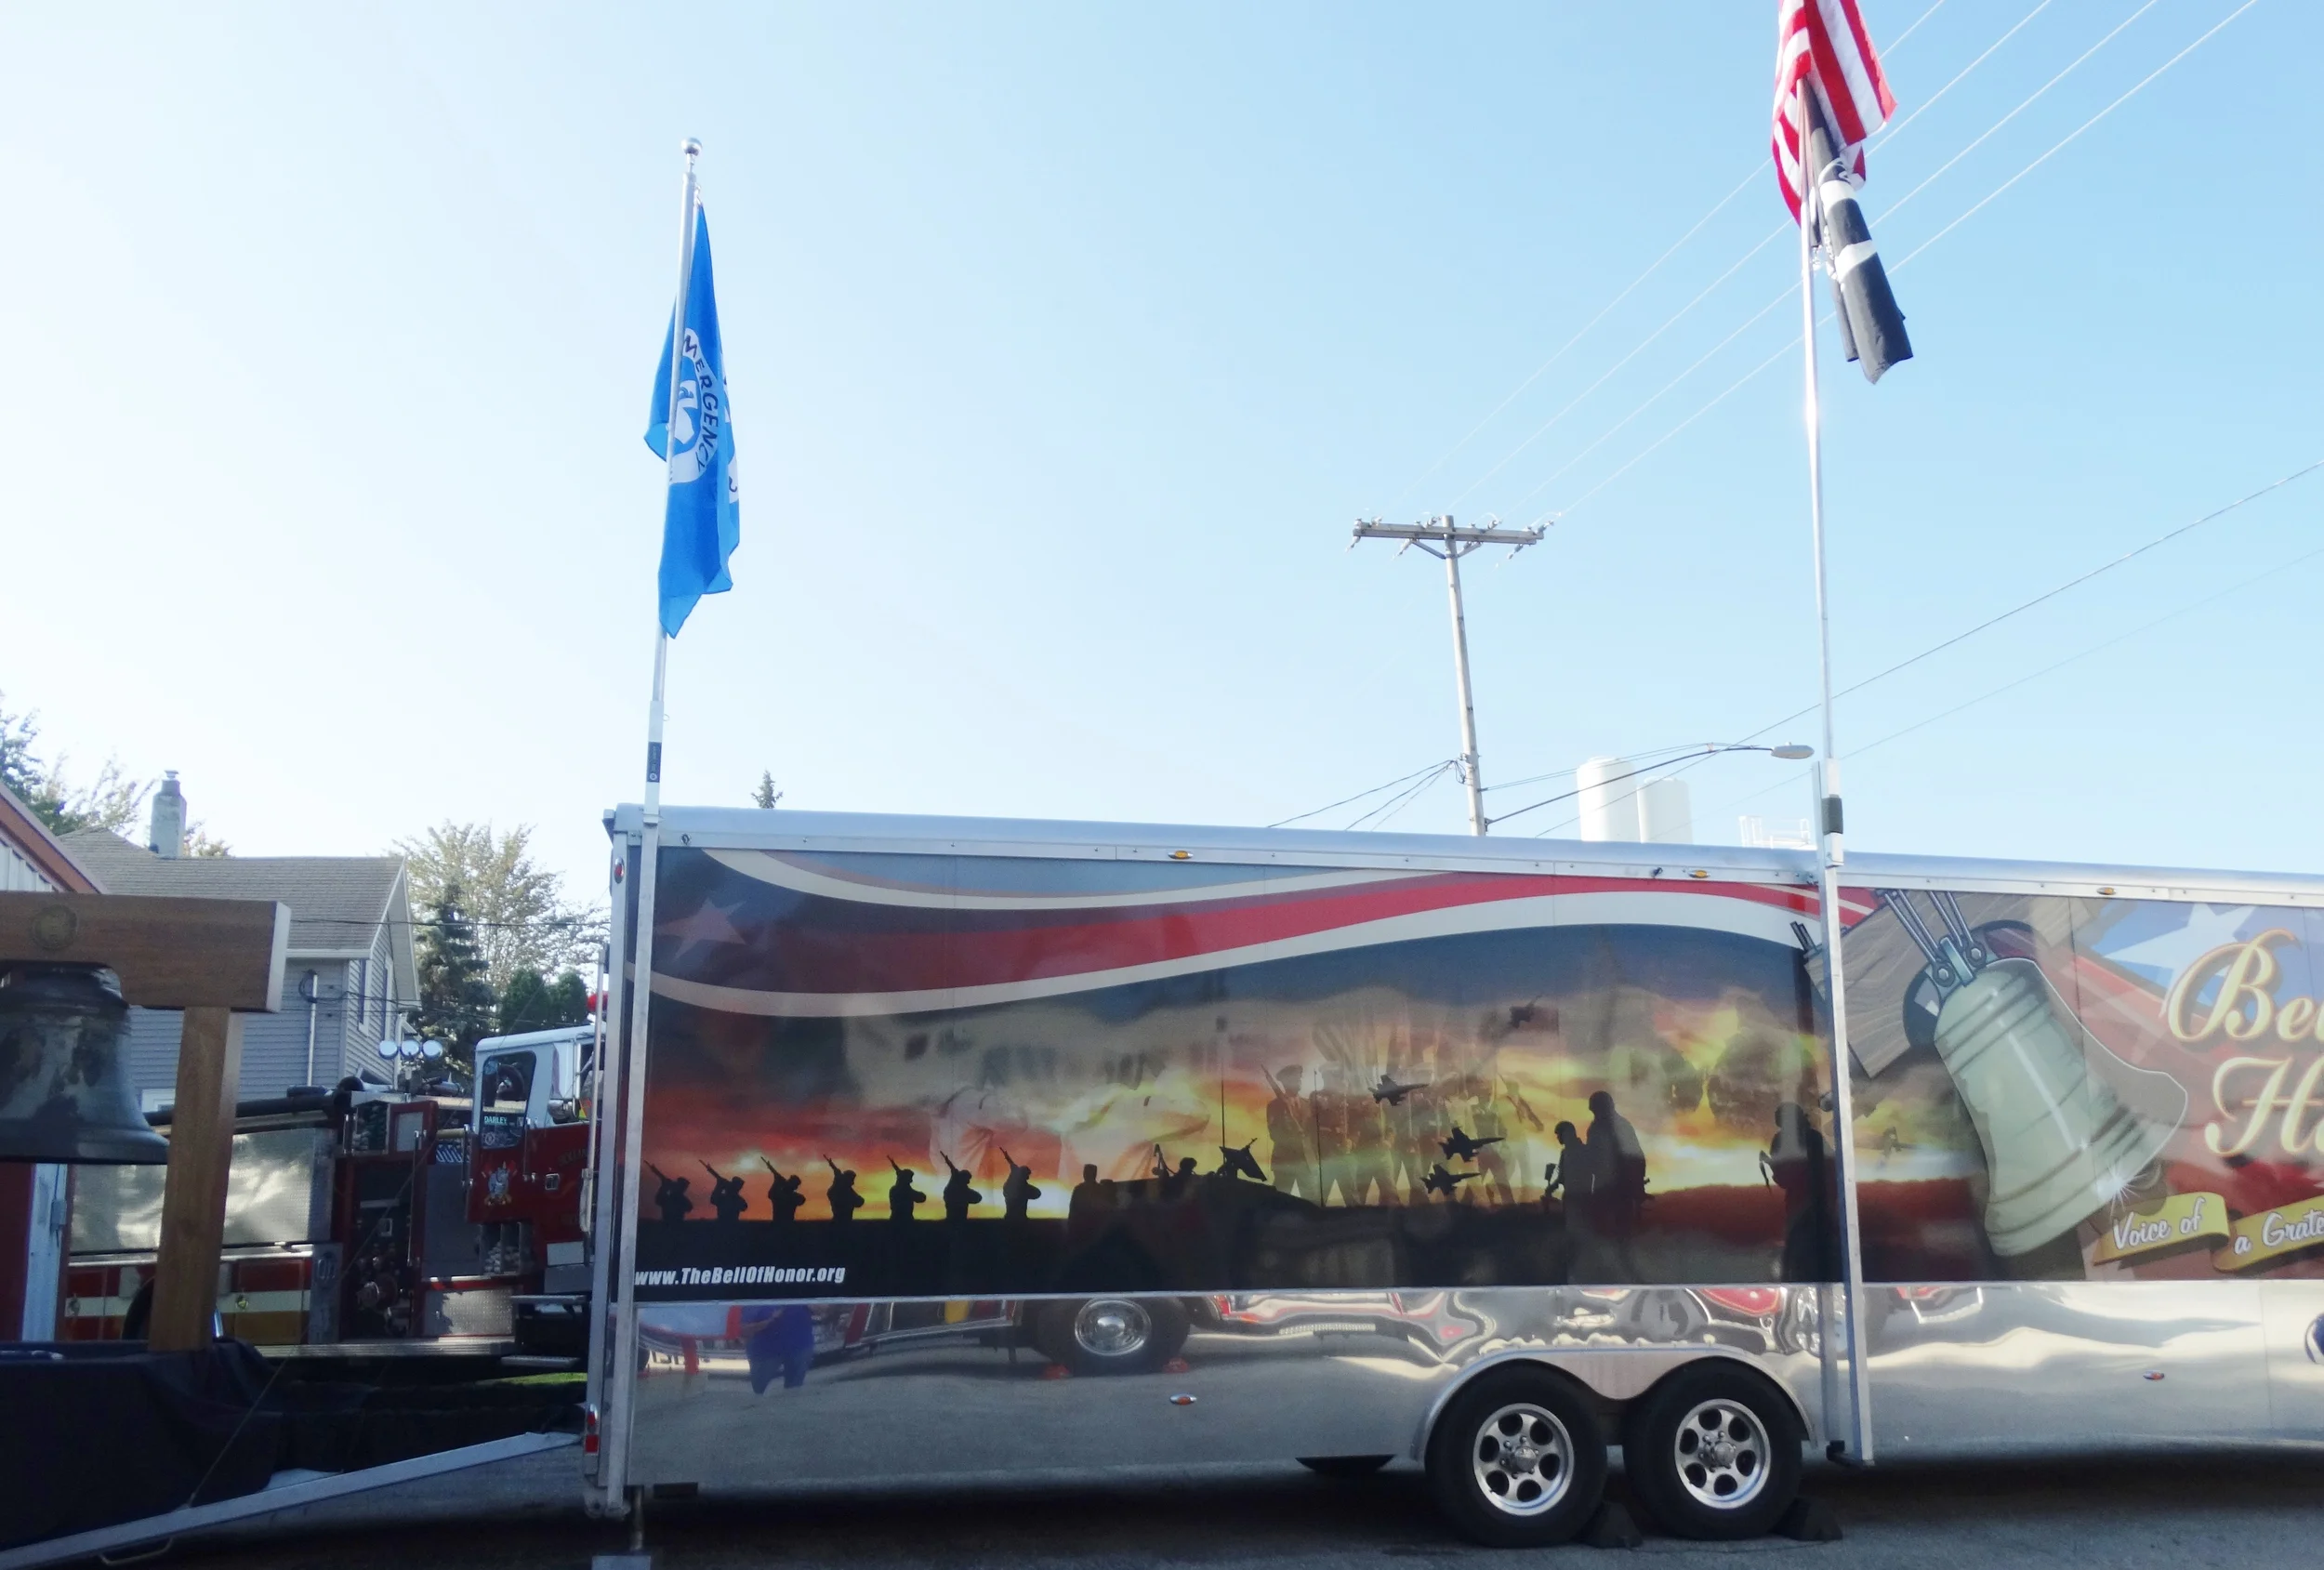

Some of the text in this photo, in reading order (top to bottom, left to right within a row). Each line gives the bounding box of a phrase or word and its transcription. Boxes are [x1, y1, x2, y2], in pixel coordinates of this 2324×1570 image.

[2204, 1055, 2324, 1156] H
[2113, 1196, 2206, 1250] Voice of
[2234, 1235, 2253, 1255] a
[635, 1265, 847, 1286] www.TheBellOfHonor.org
